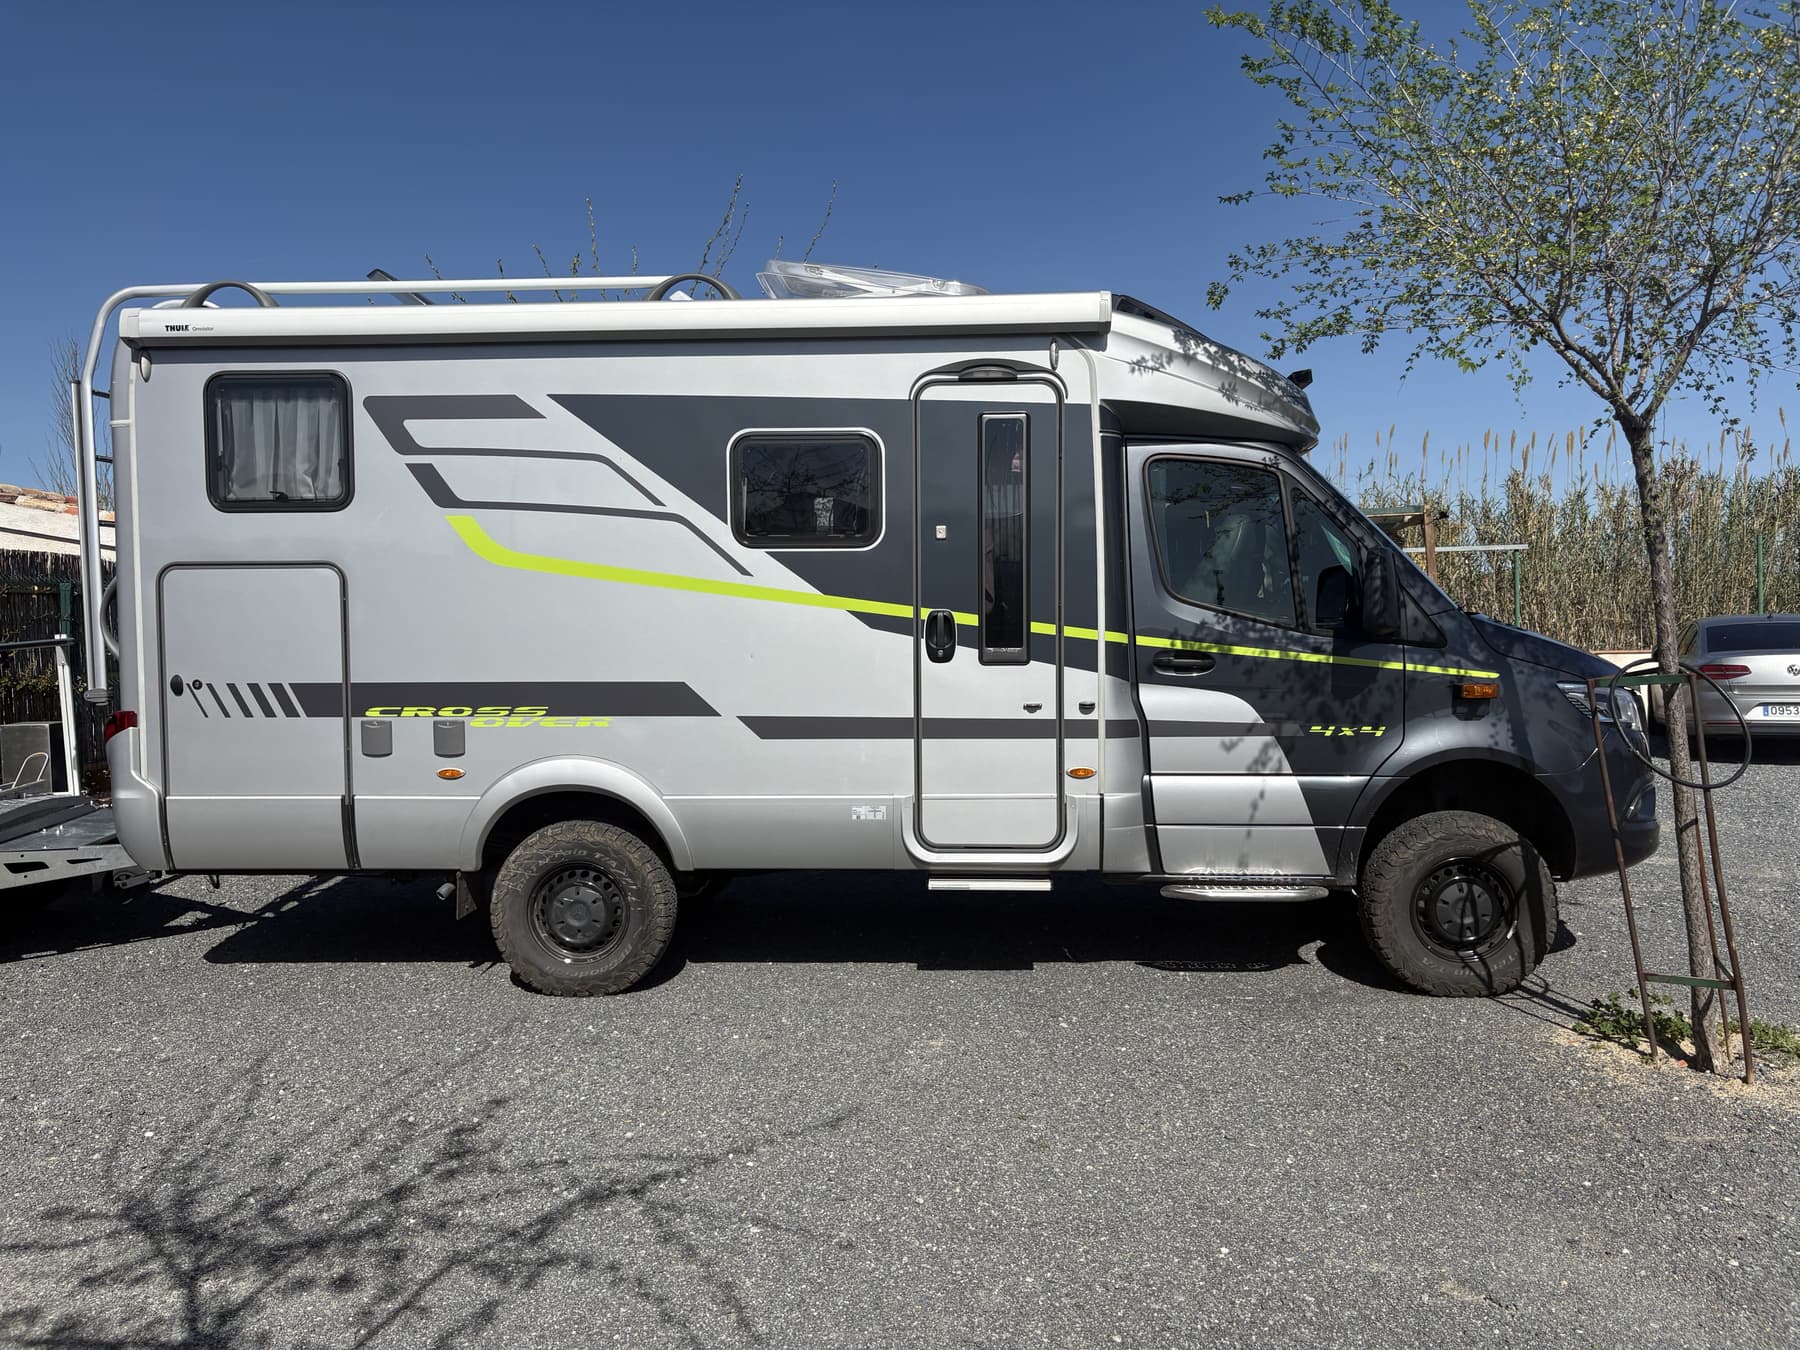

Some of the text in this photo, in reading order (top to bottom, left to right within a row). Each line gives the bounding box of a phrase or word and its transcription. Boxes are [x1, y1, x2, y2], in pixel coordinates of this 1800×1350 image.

[364, 706, 549, 717] CROSS
[1770, 706, 1800, 716] 0953
[469, 717, 611, 728] OVER
[1309, 726, 1387, 736] 4x4
